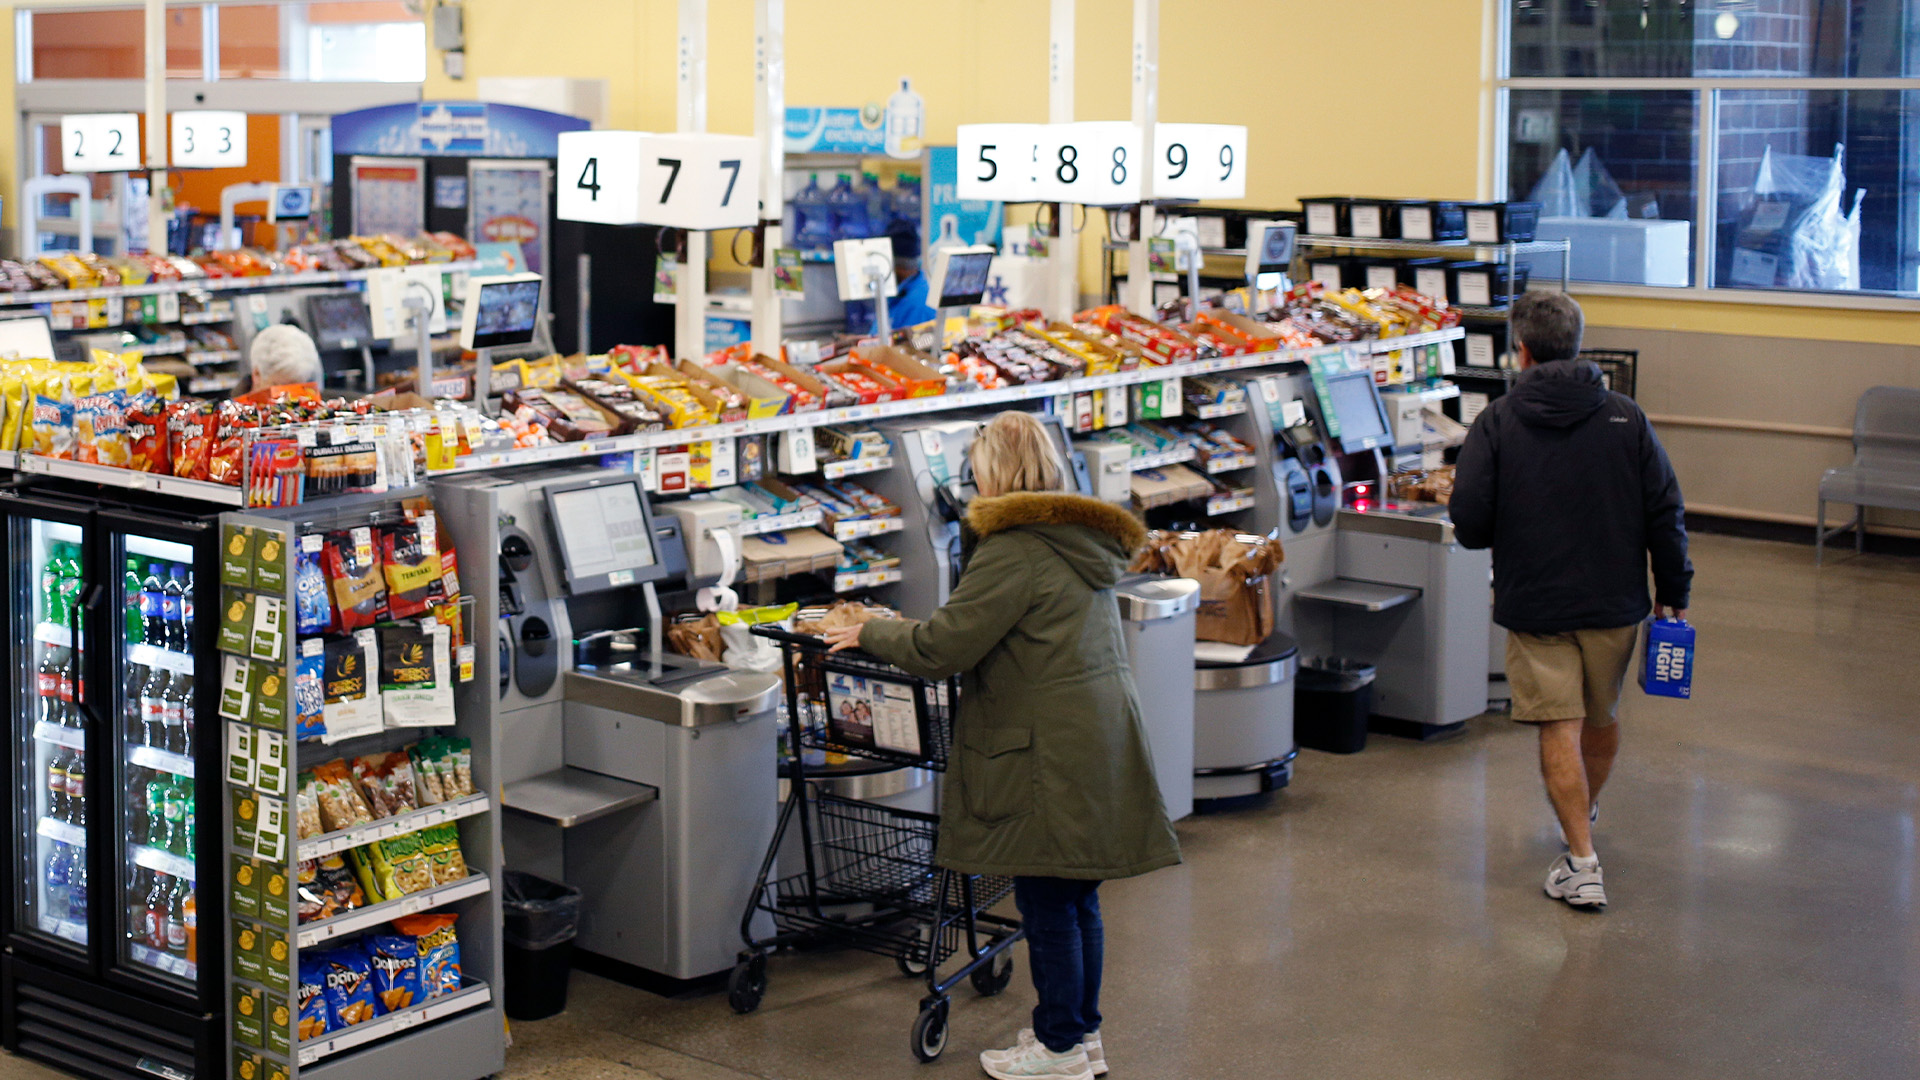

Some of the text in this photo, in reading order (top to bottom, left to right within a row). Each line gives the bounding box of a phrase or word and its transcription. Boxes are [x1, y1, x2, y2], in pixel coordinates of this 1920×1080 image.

[74, 129, 123, 157] 2 2
[184, 126, 232, 154] 3 3
[577, 158, 601, 202] 4
[977, 144, 998, 182] 5
[1056, 144, 1079, 184] 8
[1111, 146, 1127, 185] 8
[1167, 142, 1234, 182] 9 9
[657, 158, 742, 207] 7 7
[1656, 641, 1674, 682] LIGHT
[1670, 647, 1686, 680] BUD
[372, 955, 416, 971] Doritos
